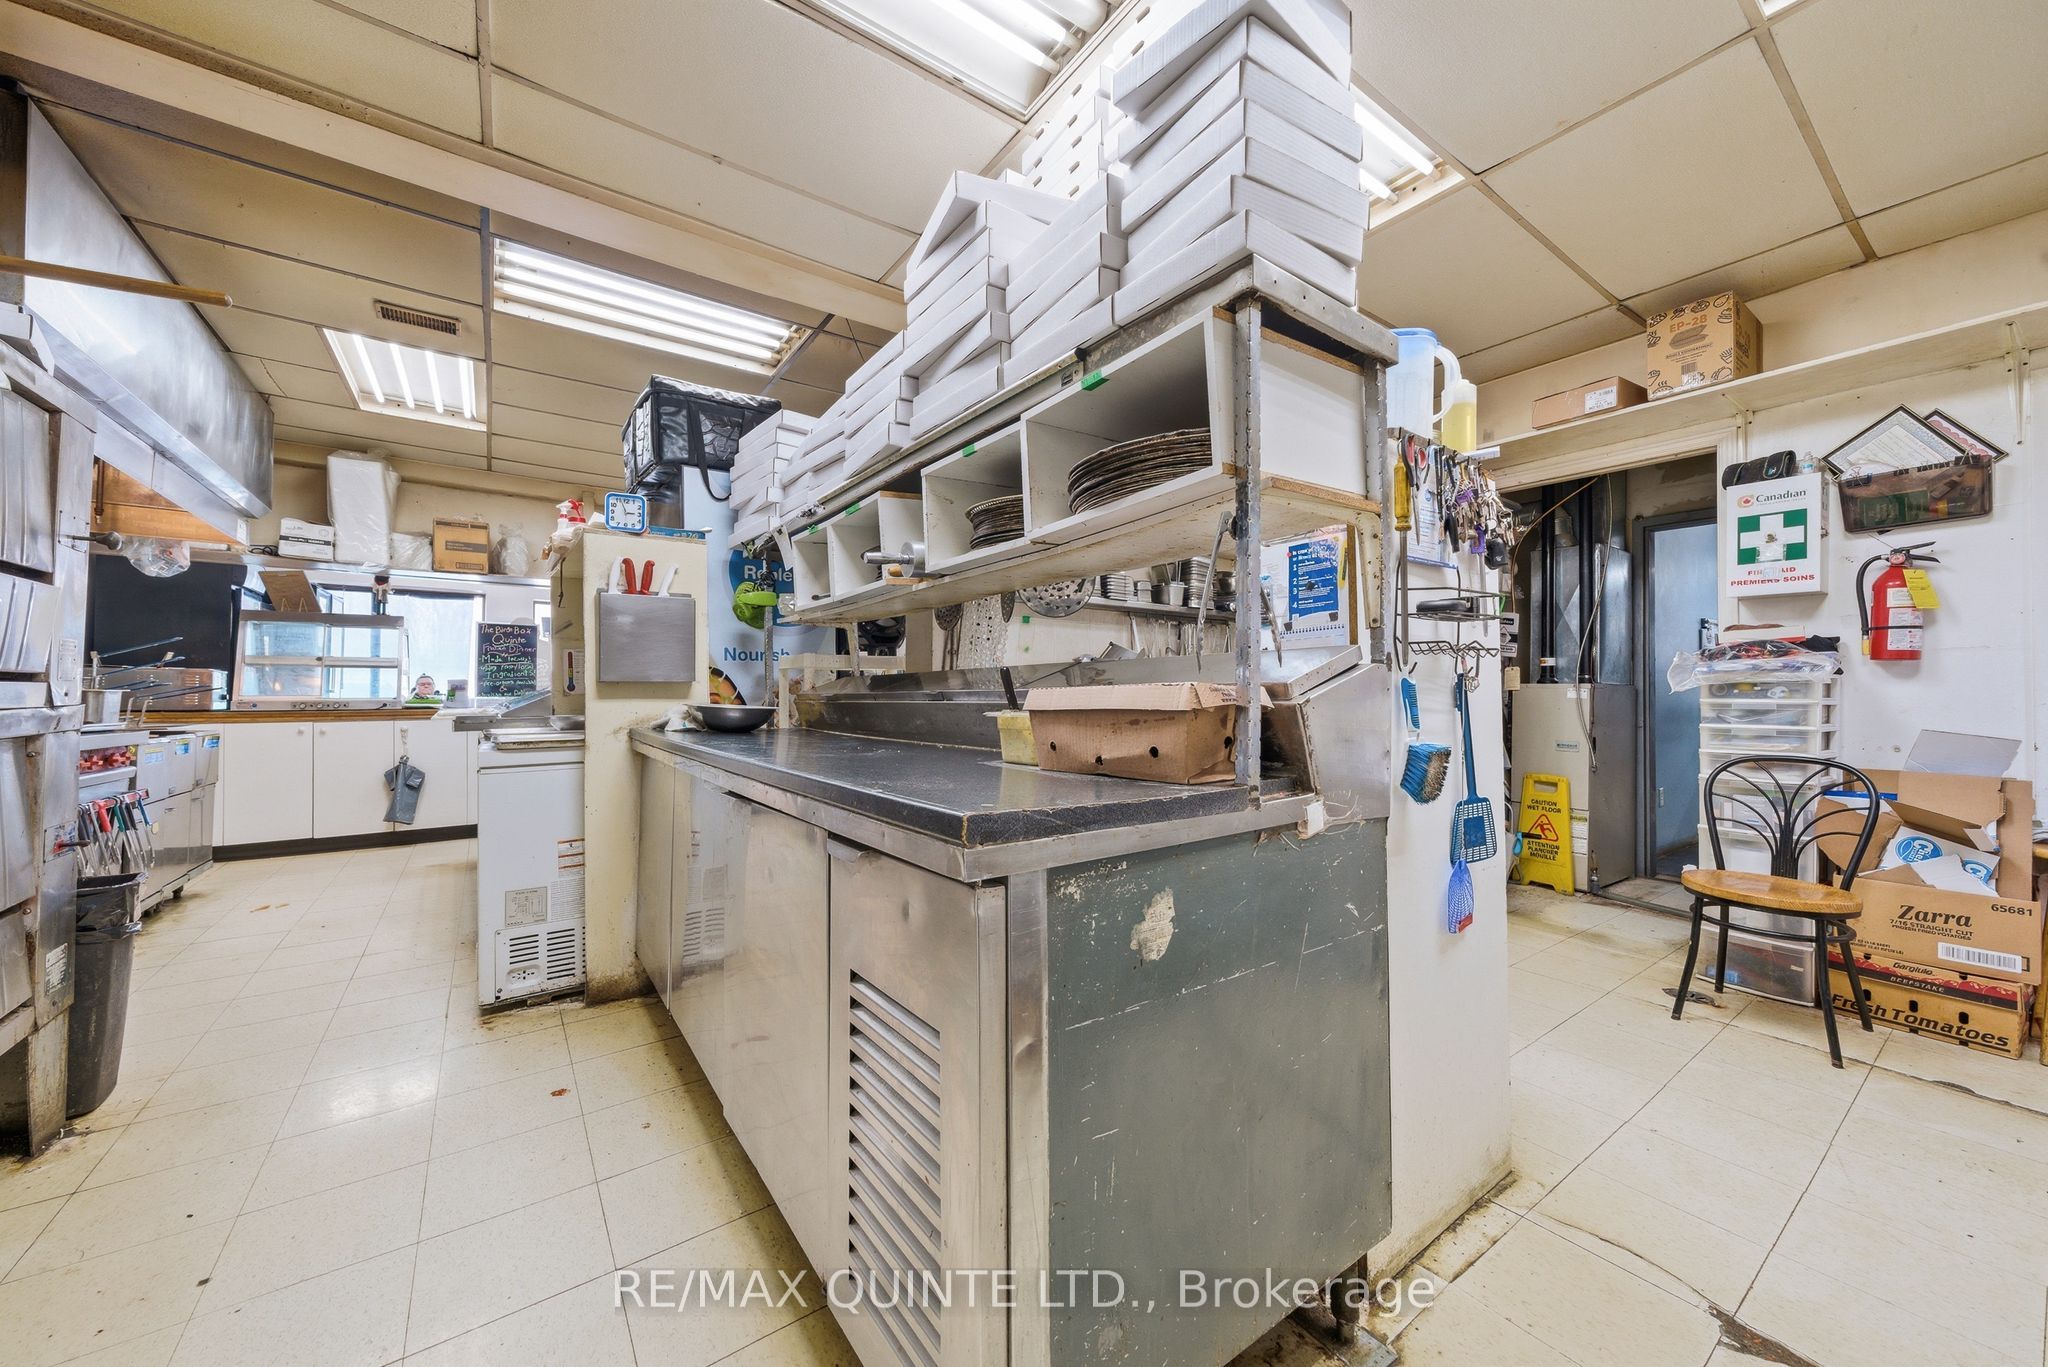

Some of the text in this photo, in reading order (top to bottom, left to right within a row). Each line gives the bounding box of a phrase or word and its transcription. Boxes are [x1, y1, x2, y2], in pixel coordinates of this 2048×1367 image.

[1756, 489, 1806, 503] Canadian
[1731, 574, 1815, 586] PREMIERS SOINS
[481, 624, 494, 634] The
[514, 626, 532, 635] Box
[492, 633, 527, 645] Quinte
[723, 647, 790, 661] Noursh
[1531, 799, 1557, 807] CAUTION
[1541, 806, 1561, 814] FLOOR
[1527, 840, 1559, 850] ATTENTION
[1897, 904, 1973, 928] Zarra
[1991, 903, 2033, 917] 65681
[1889, 919, 1974, 937] 7/16 STRAIGHT CUT
[1891, 924, 1916, 932] FROZEN
[1892, 1008, 2010, 1047] Tomatoes
